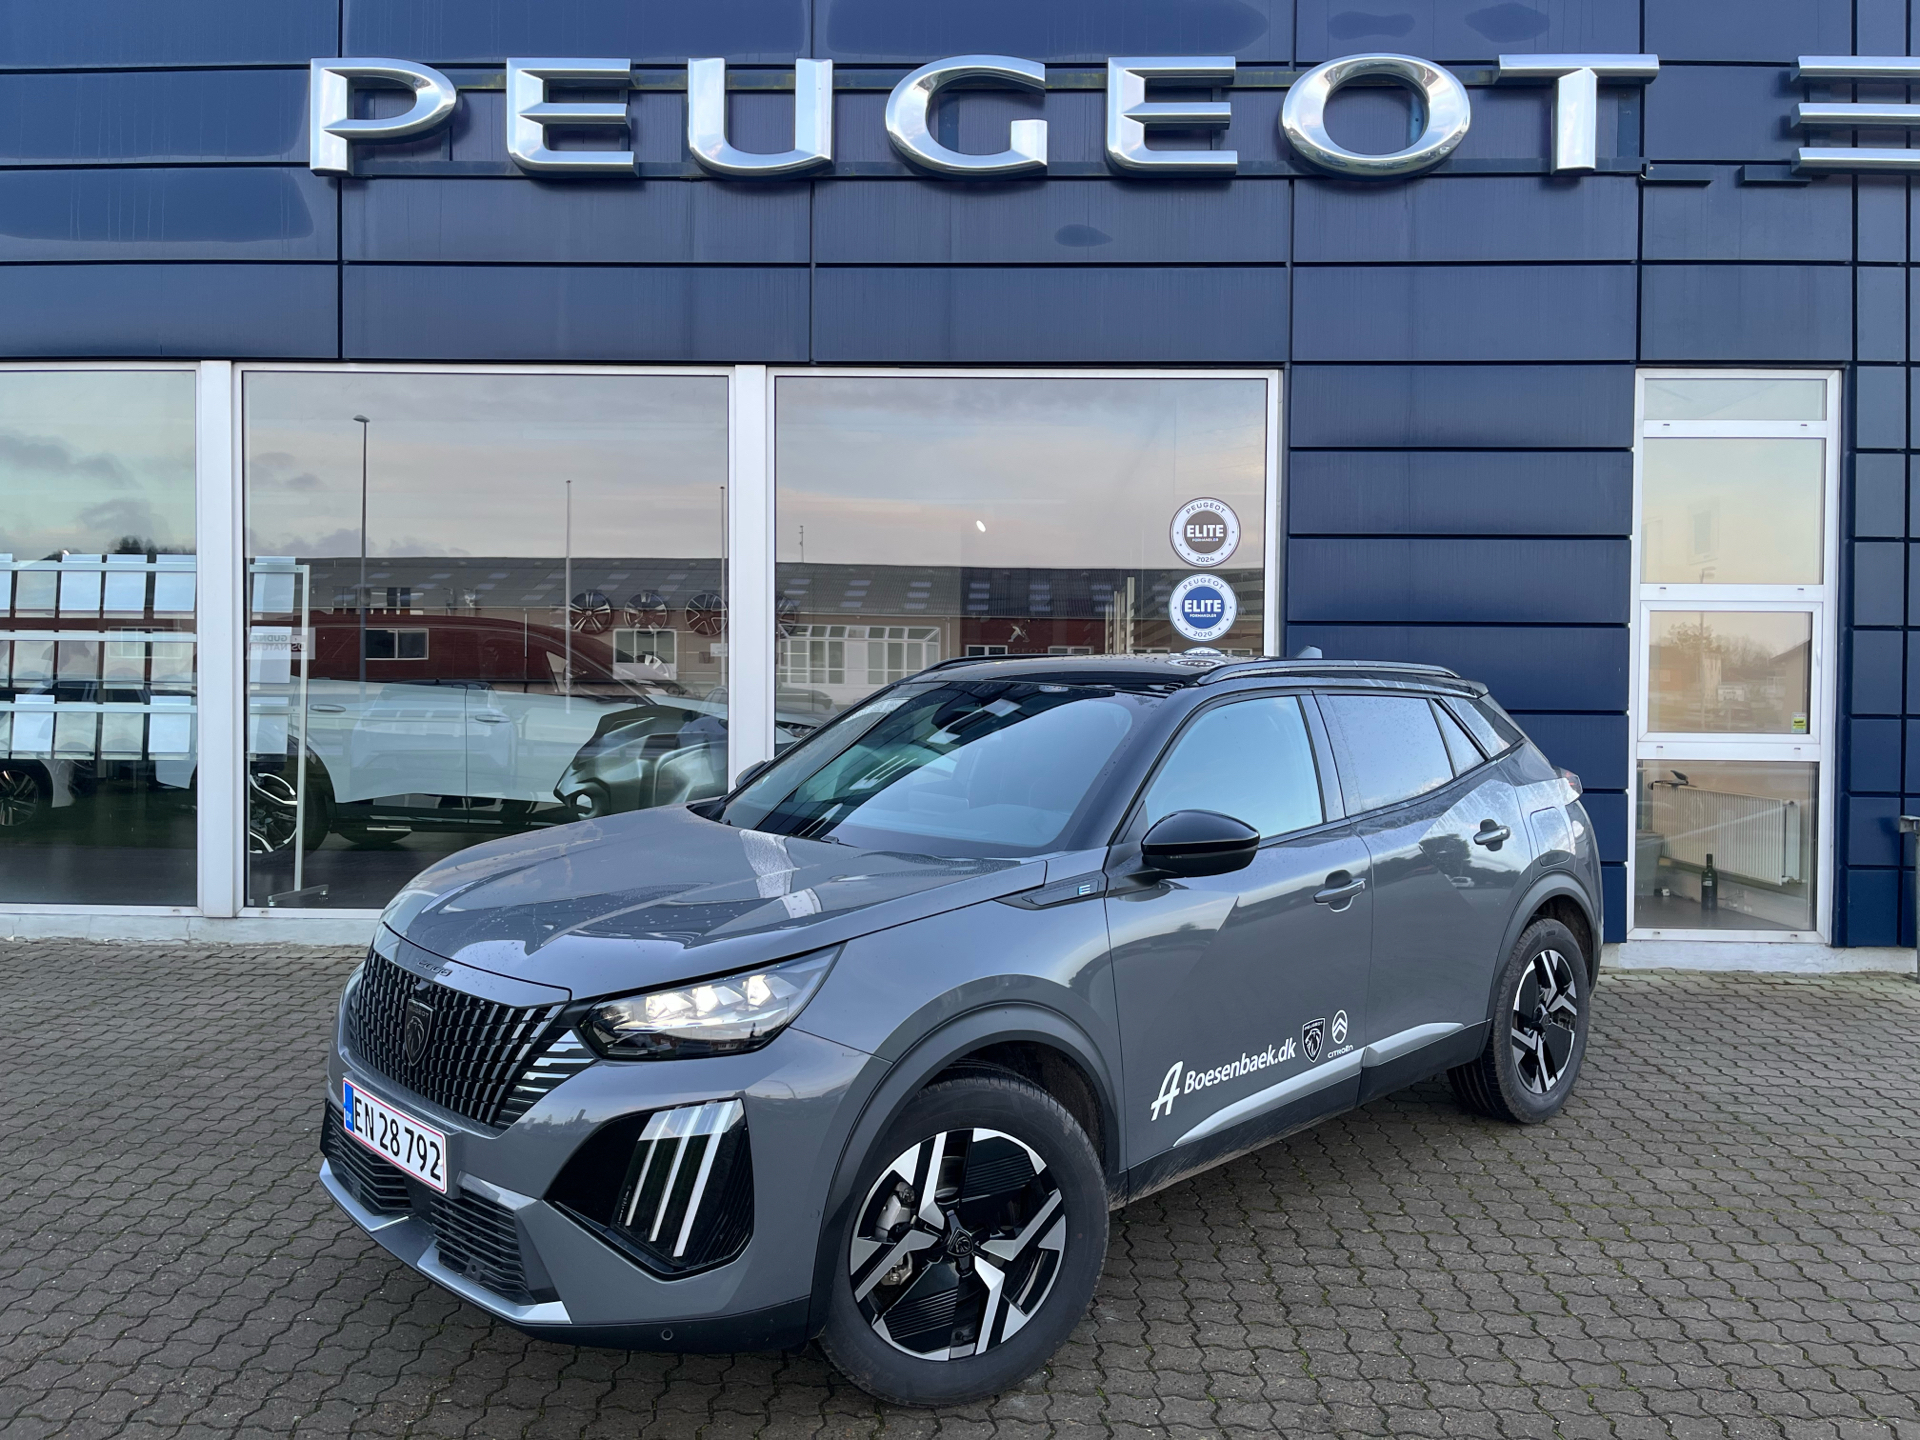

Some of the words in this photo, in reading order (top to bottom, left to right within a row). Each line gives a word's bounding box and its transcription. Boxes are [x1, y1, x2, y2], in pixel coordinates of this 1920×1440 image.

[309, 53, 1661, 179] PEUGEOT
[1185, 502, 1226, 514] PEUGEOT
[1186, 524, 1224, 537] ELITE
[1183, 577, 1225, 590] PEUGEOT
[1184, 599, 1222, 613] ELITE
[1184, 1037, 1297, 1094] Boesenbaek.dk
[354, 1096, 375, 1142] EN
[379, 1111, 400, 1157] 28
[404, 1126, 441, 1182] 792
